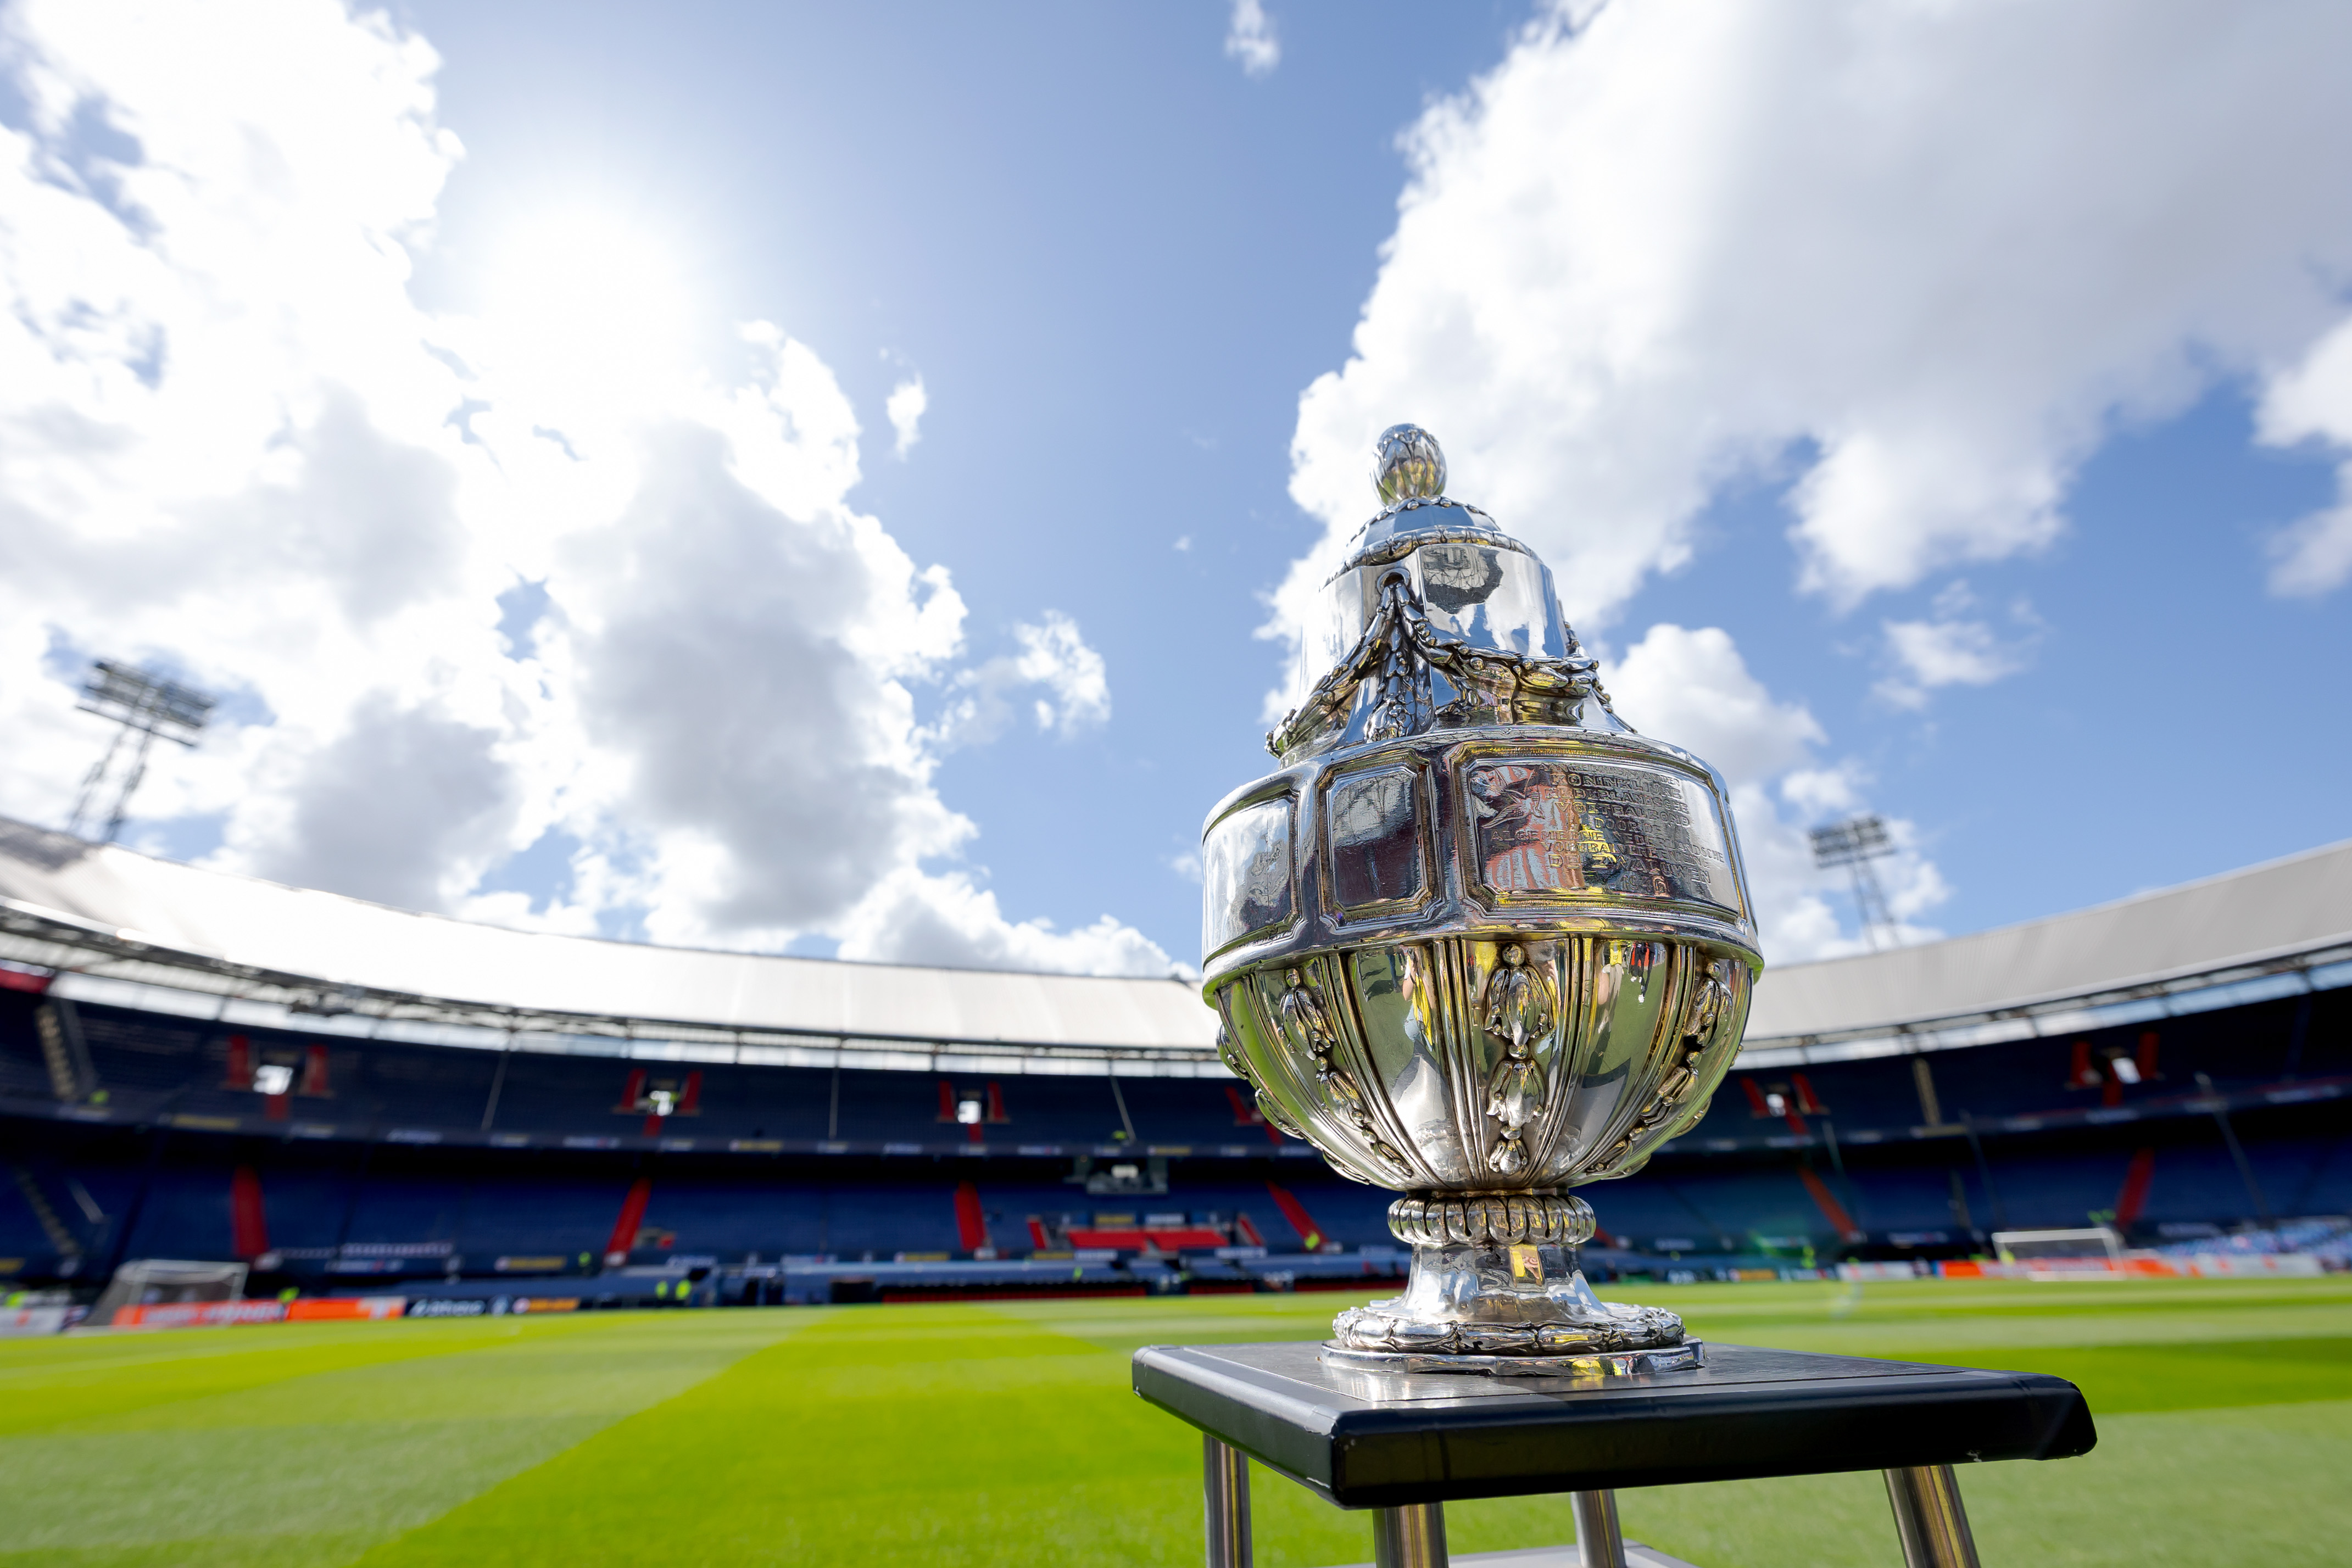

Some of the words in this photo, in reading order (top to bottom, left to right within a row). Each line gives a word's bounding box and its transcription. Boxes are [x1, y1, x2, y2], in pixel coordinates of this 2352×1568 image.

[1549, 773, 1682, 800] KONINKLIJKE
[1544, 788, 1690, 814] NEDERLANDSCHE
[1554, 801, 1691, 827] VOETBALBOND
[1594, 817, 1640, 832] DOOR
[1548, 853, 1582, 869] DE
[1591, 852, 1712, 885] ZWALUWEN
